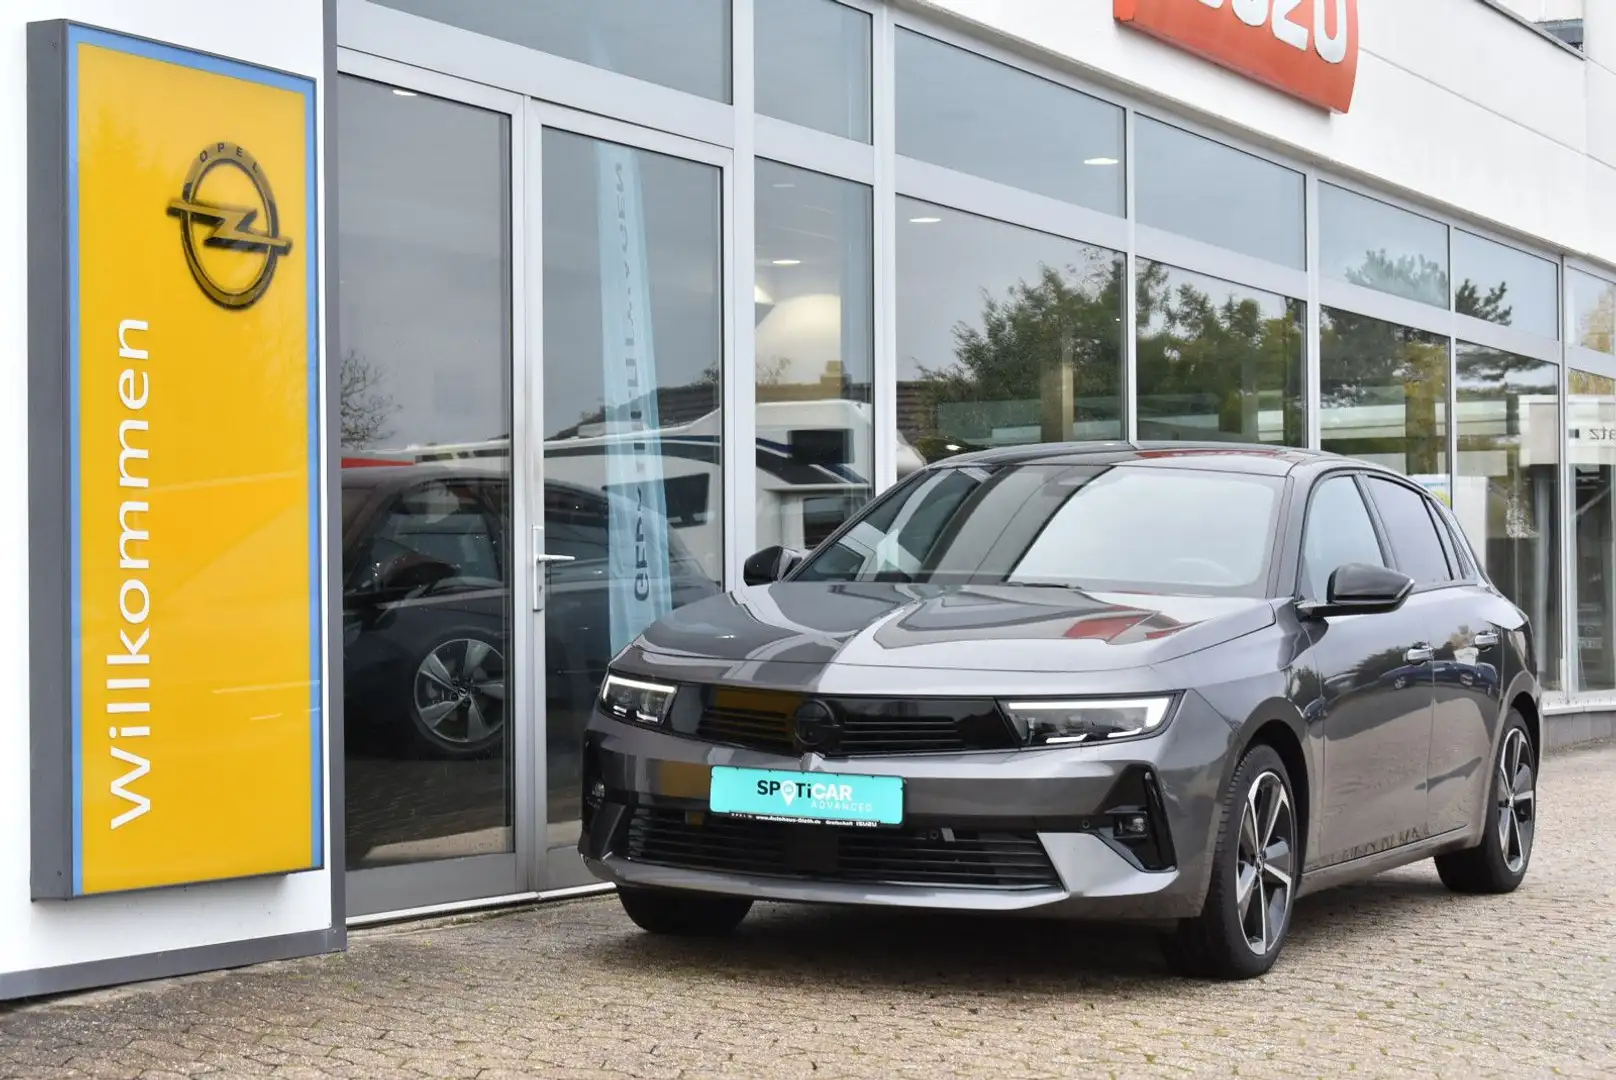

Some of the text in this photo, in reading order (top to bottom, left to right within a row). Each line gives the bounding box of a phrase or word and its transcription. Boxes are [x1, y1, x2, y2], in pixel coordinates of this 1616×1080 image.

[200, 143, 258, 173] OPEL
[106, 318, 151, 830] Willkommen
[811, 800, 873, 812] ADVANCED
